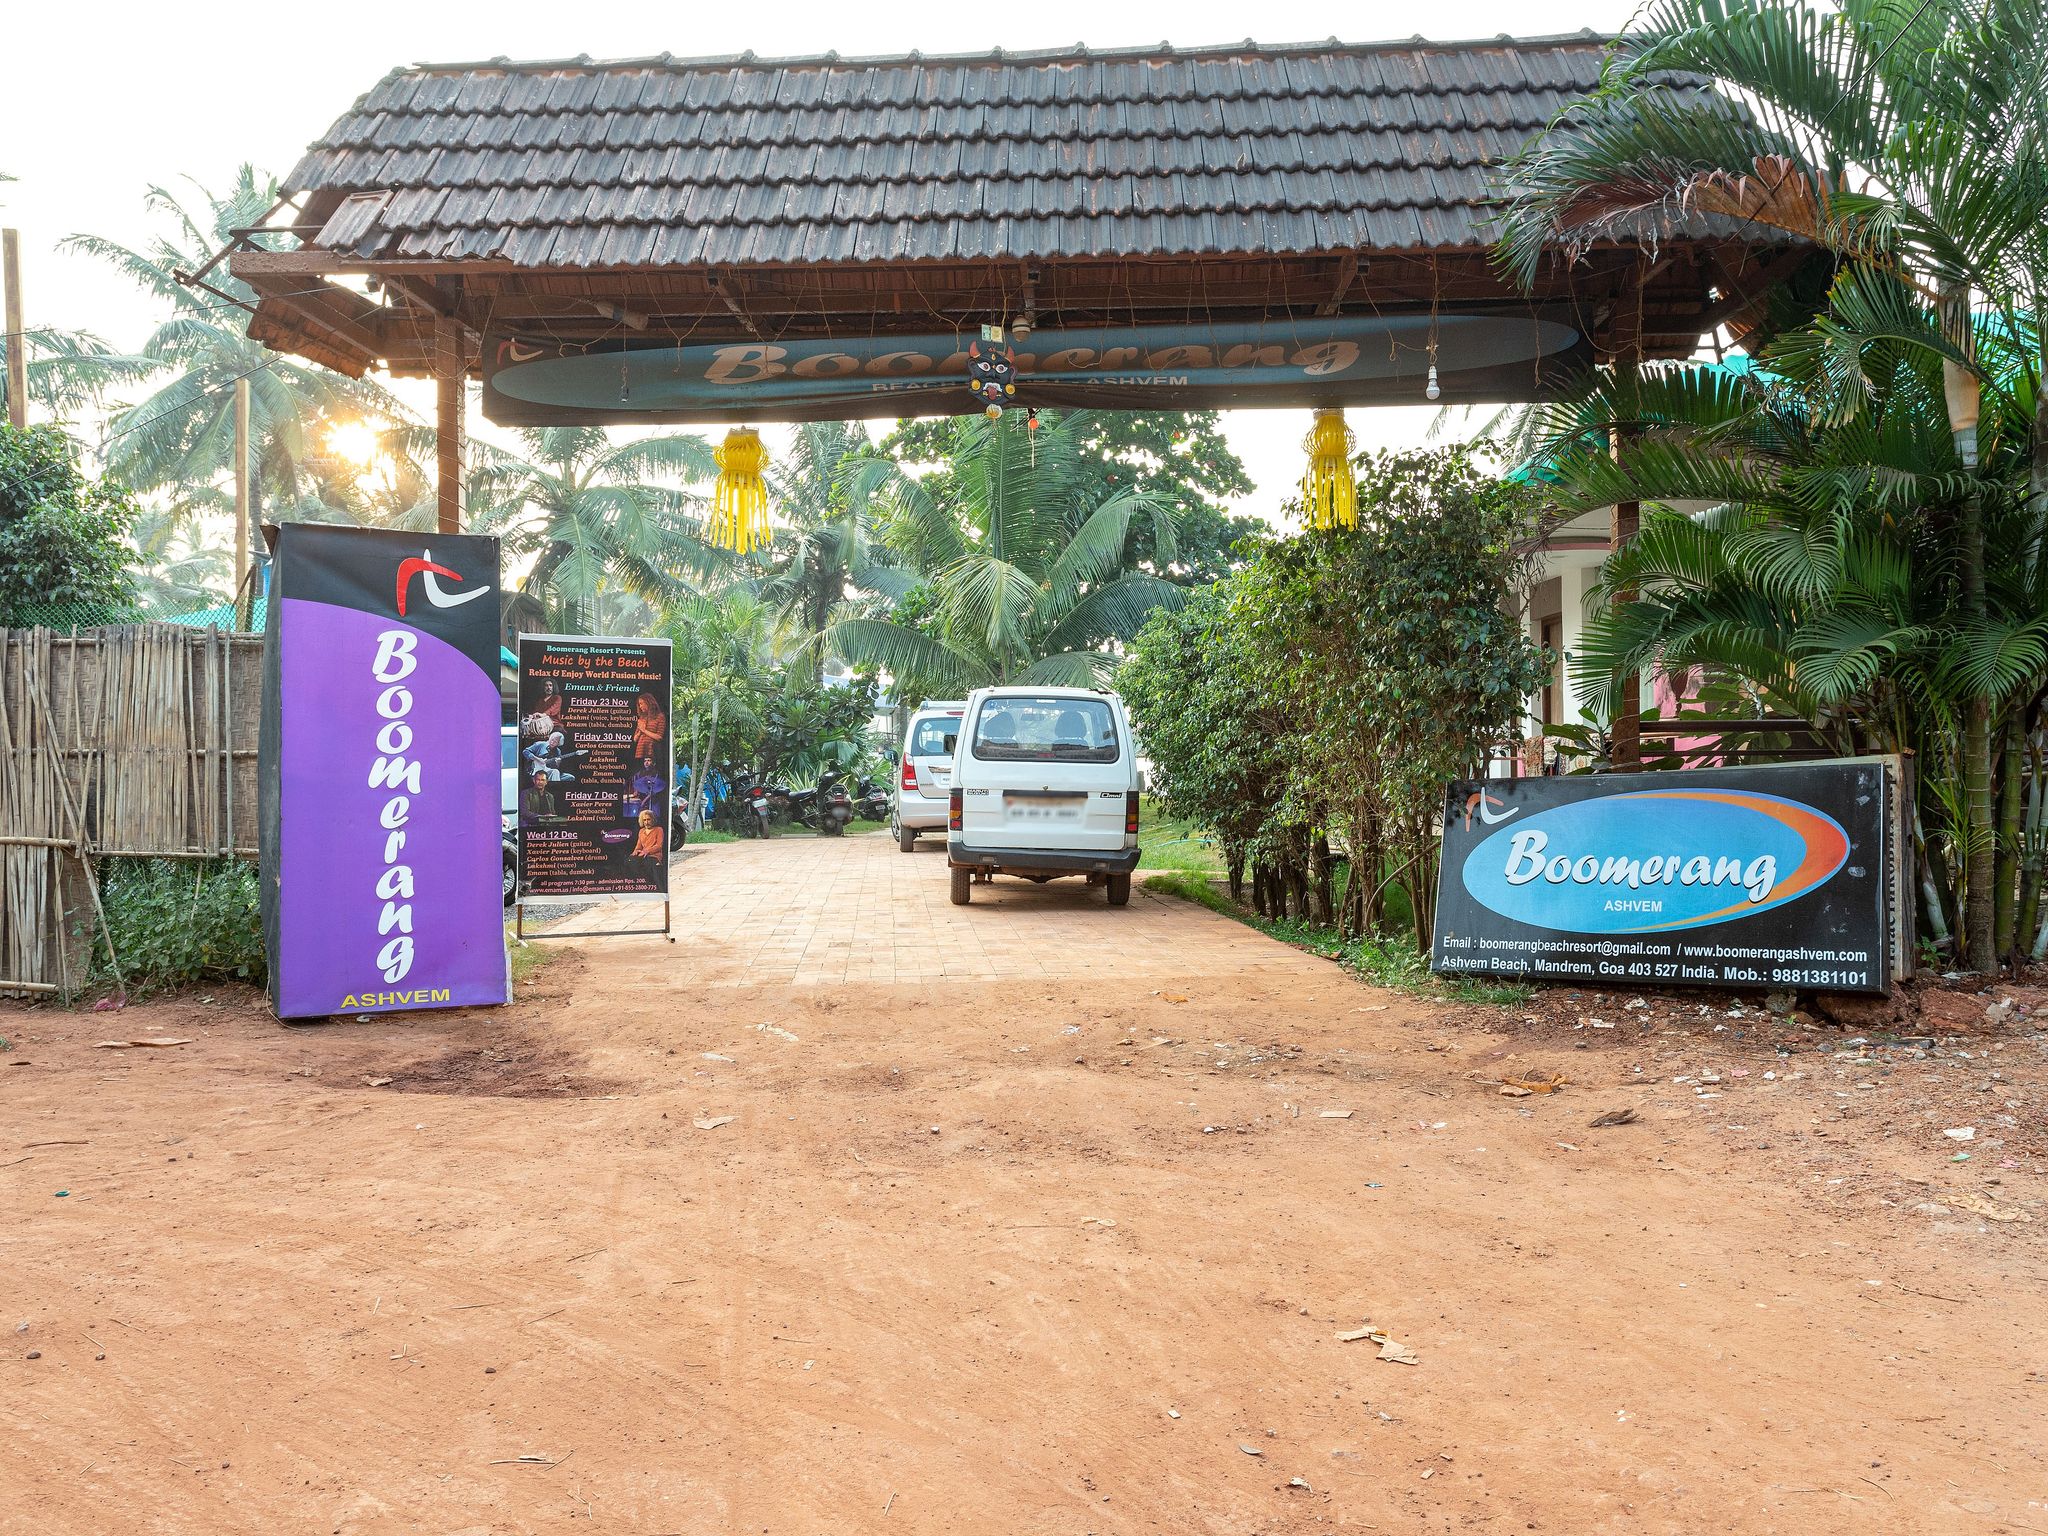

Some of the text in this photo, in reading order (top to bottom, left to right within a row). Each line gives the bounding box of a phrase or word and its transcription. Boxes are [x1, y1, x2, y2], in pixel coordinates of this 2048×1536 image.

[1087, 376, 1189, 386] ASHVEM
[546, 645, 588, 654] Boomerang
[542, 655, 650, 669] Music by the Beach
[529, 669, 551, 677] Relax
[561, 670, 584, 679] Enjoy
[585, 671, 609, 679] World
[565, 683, 640, 692] Emam & Friends
[571, 698, 598, 707] Friday
[574, 733, 601, 742] Friday
[565, 792, 592, 800] Friday
[367, 630, 422, 985] Boomerang
[527, 831, 578, 839] Wed 12 Dec
[1504, 830, 1776, 903] Boomerang
[1604, 900, 1662, 912] ASHVEM
[1443, 936, 1471, 948] Email
[1479, 937, 1671, 956] boomerangbeachresort@gmail.com
[1684, 944, 1867, 962] www.boomerangashvem.com
[1441, 955, 1488, 969] Ashvem
[1491, 957, 1531, 973] Beach,
[1535, 959, 1595, 975] Mandrem,
[1599, 961, 1625, 975] Goa
[1628, 962, 1651, 976] 403
[1654, 964, 1678, 977] 527
[1682, 965, 1718, 979] India.
[1772, 969, 1867, 985] 9881381101
[341, 989, 450, 1008] ASHVEM
